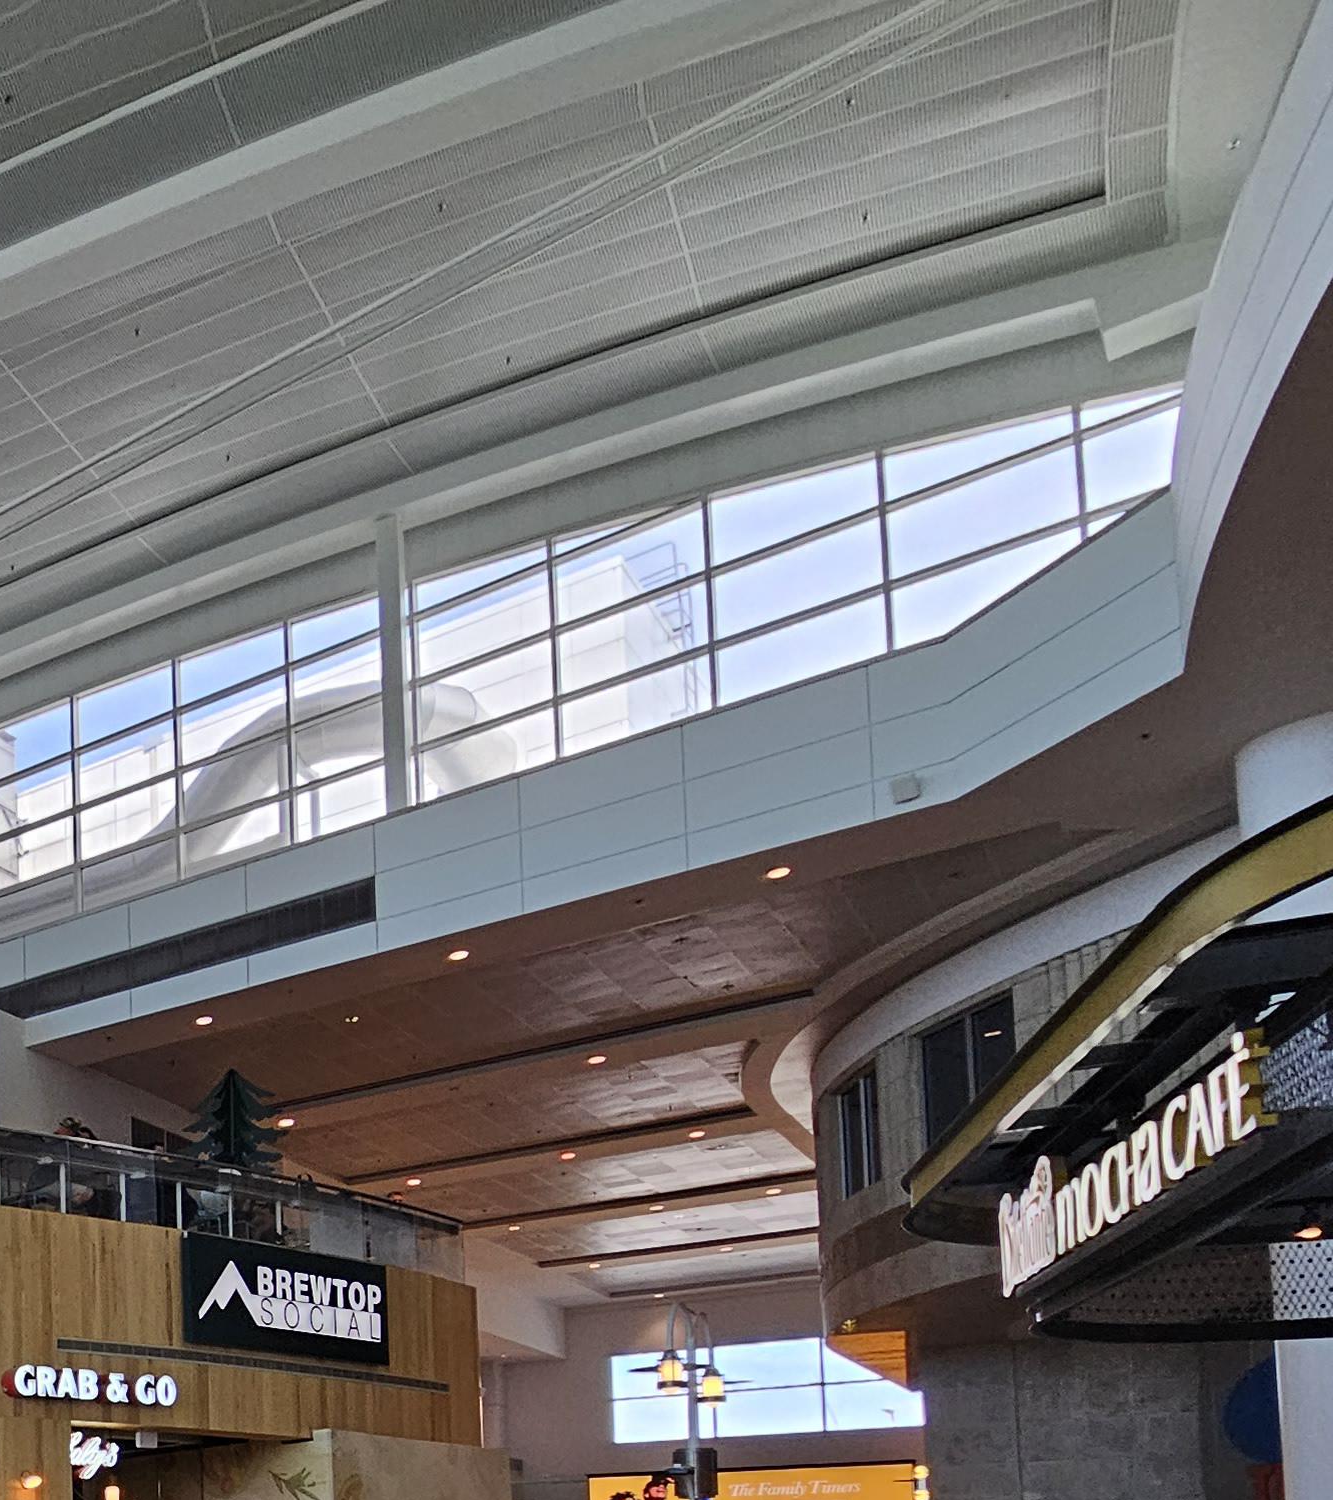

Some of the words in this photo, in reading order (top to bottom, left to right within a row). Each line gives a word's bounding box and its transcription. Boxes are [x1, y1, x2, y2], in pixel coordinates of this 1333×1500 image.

[257, 1265, 381, 1312] BREWTOP
[260, 1297, 381, 1341] SOCIAL
[14, 1364, 99, 1401] GRAB
[106, 1372, 129, 1404] &
[135, 1374, 177, 1406] GO
[728, 1483, 755, 1497] The
[758, 1481, 805, 1499] Family
